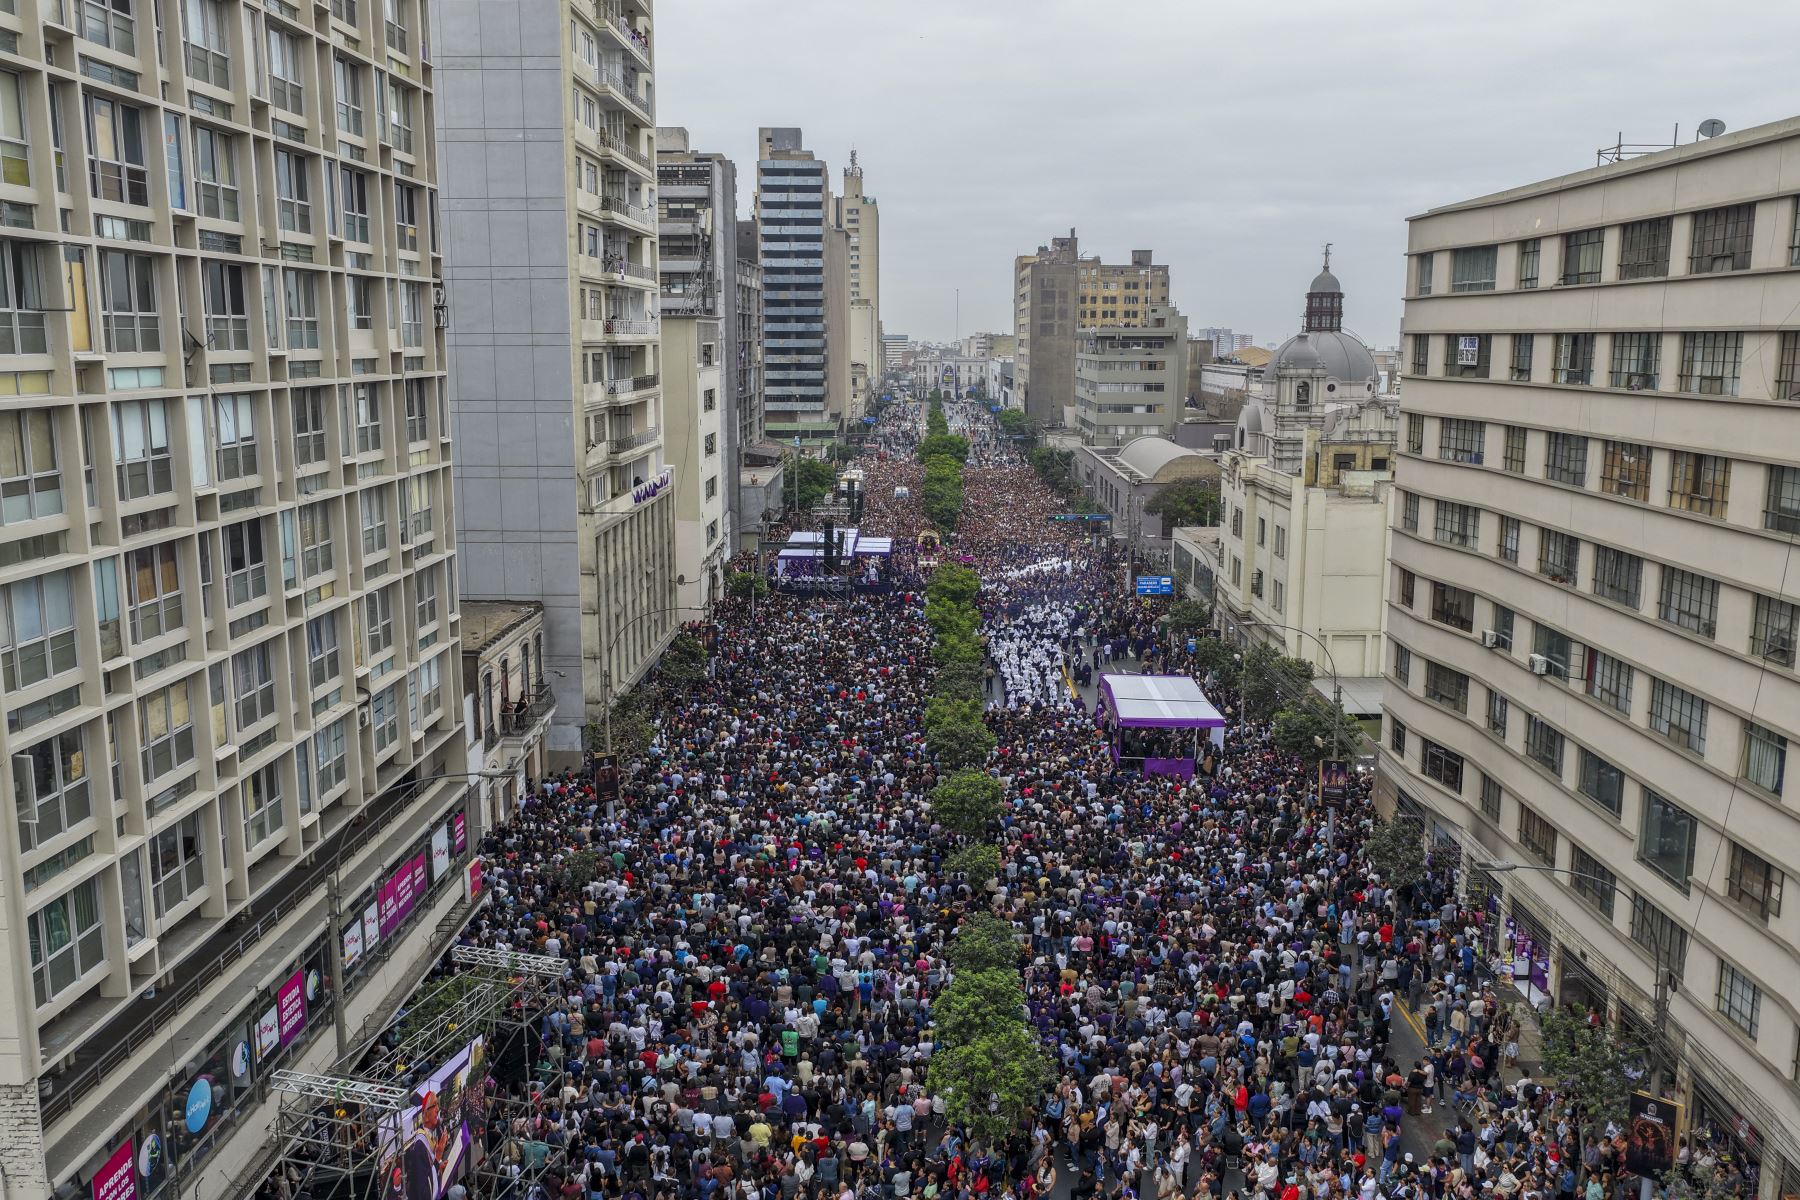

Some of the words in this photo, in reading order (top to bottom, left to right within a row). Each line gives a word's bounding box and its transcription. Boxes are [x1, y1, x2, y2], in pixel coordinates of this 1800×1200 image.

[282, 984, 300, 1009] ESTUDIA
[282, 1008, 303, 1036] INTEGRAL
[99, 1156, 133, 1199] APRENDE
[118, 1175, 129, 1192] LOS
